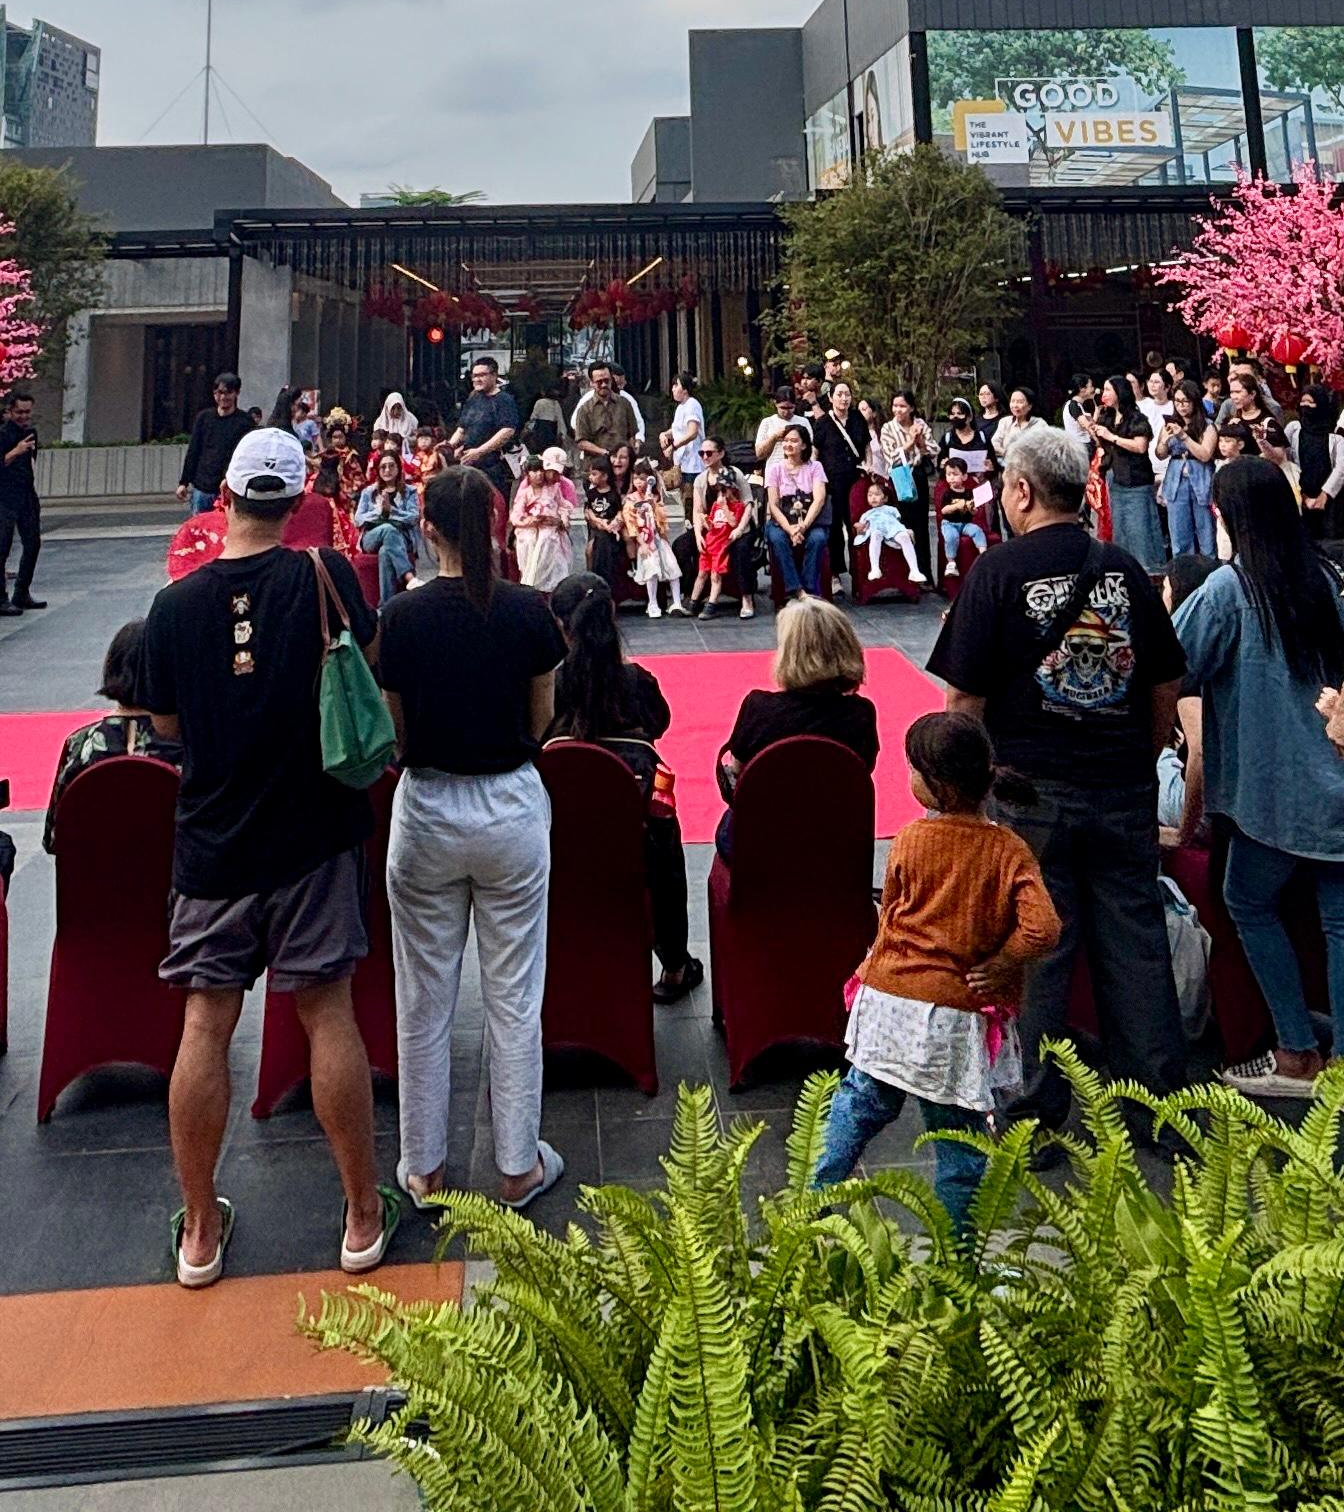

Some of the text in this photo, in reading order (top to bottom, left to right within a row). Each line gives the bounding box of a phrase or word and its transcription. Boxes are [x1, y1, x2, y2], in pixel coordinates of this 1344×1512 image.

[1013, 83, 1118, 108] GOOD
[969, 131, 1009, 139] VIBRANT
[1054, 120, 1157, 144] VIBES
[970, 140, 1020, 149] LIFESTYLE
[971, 150, 990, 158] HUB
